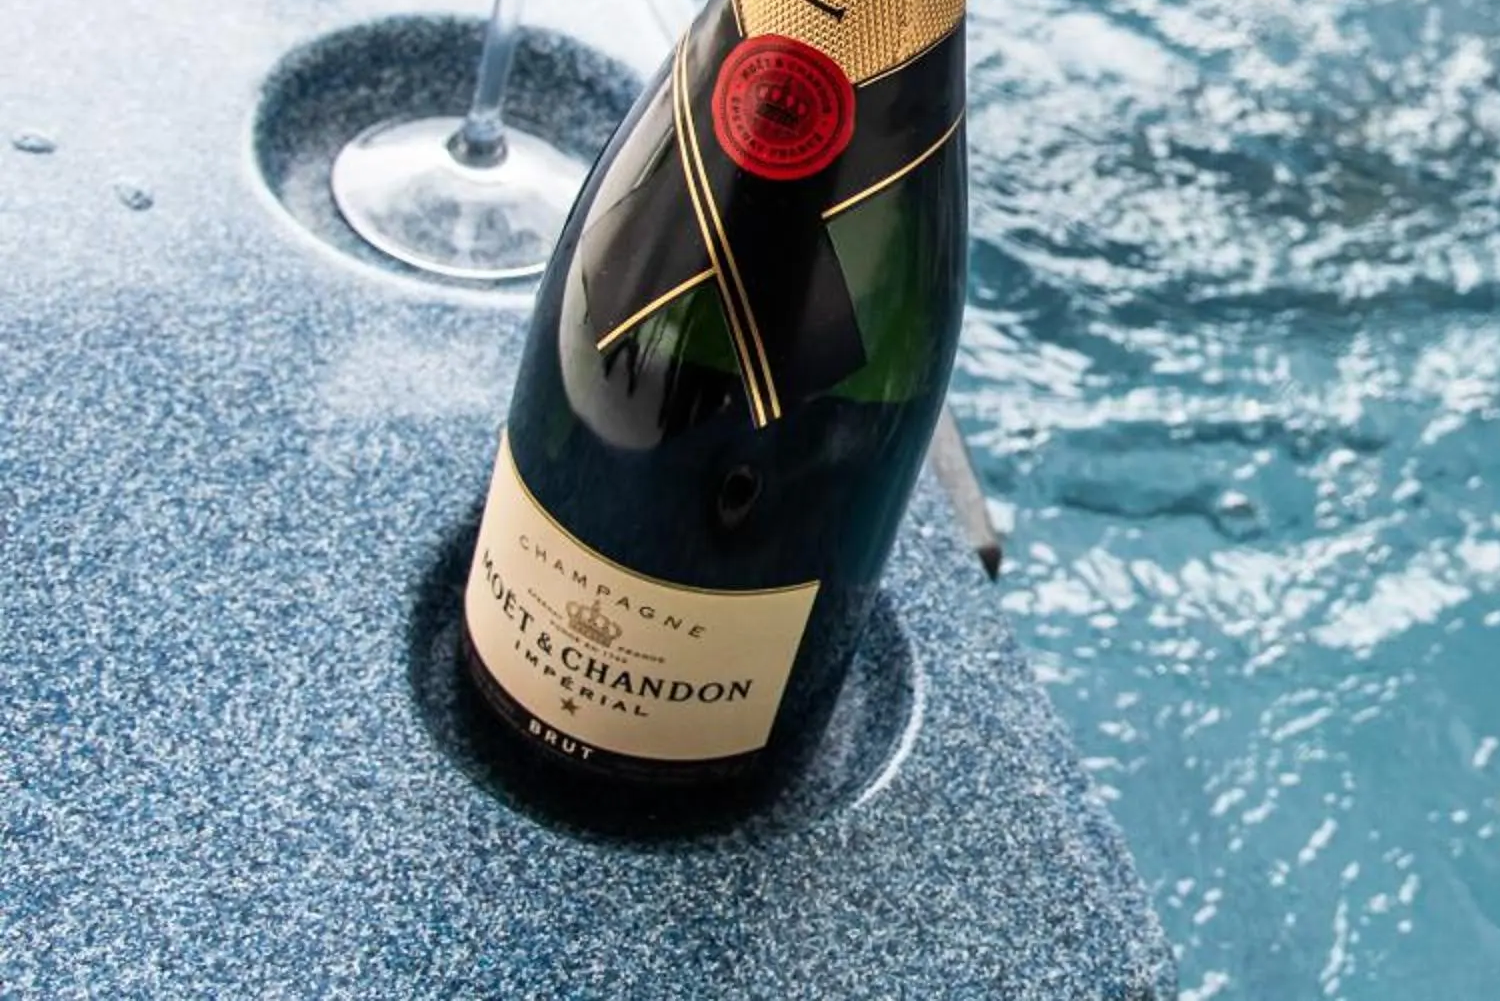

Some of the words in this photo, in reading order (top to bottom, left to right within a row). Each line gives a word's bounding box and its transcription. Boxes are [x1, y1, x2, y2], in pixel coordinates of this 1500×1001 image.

[518, 534, 708, 639] CHAMPAGNE
[536, 631, 553, 656] &
[561, 646, 754, 705] CHANDON
[528, 718, 594, 760] BRUT
